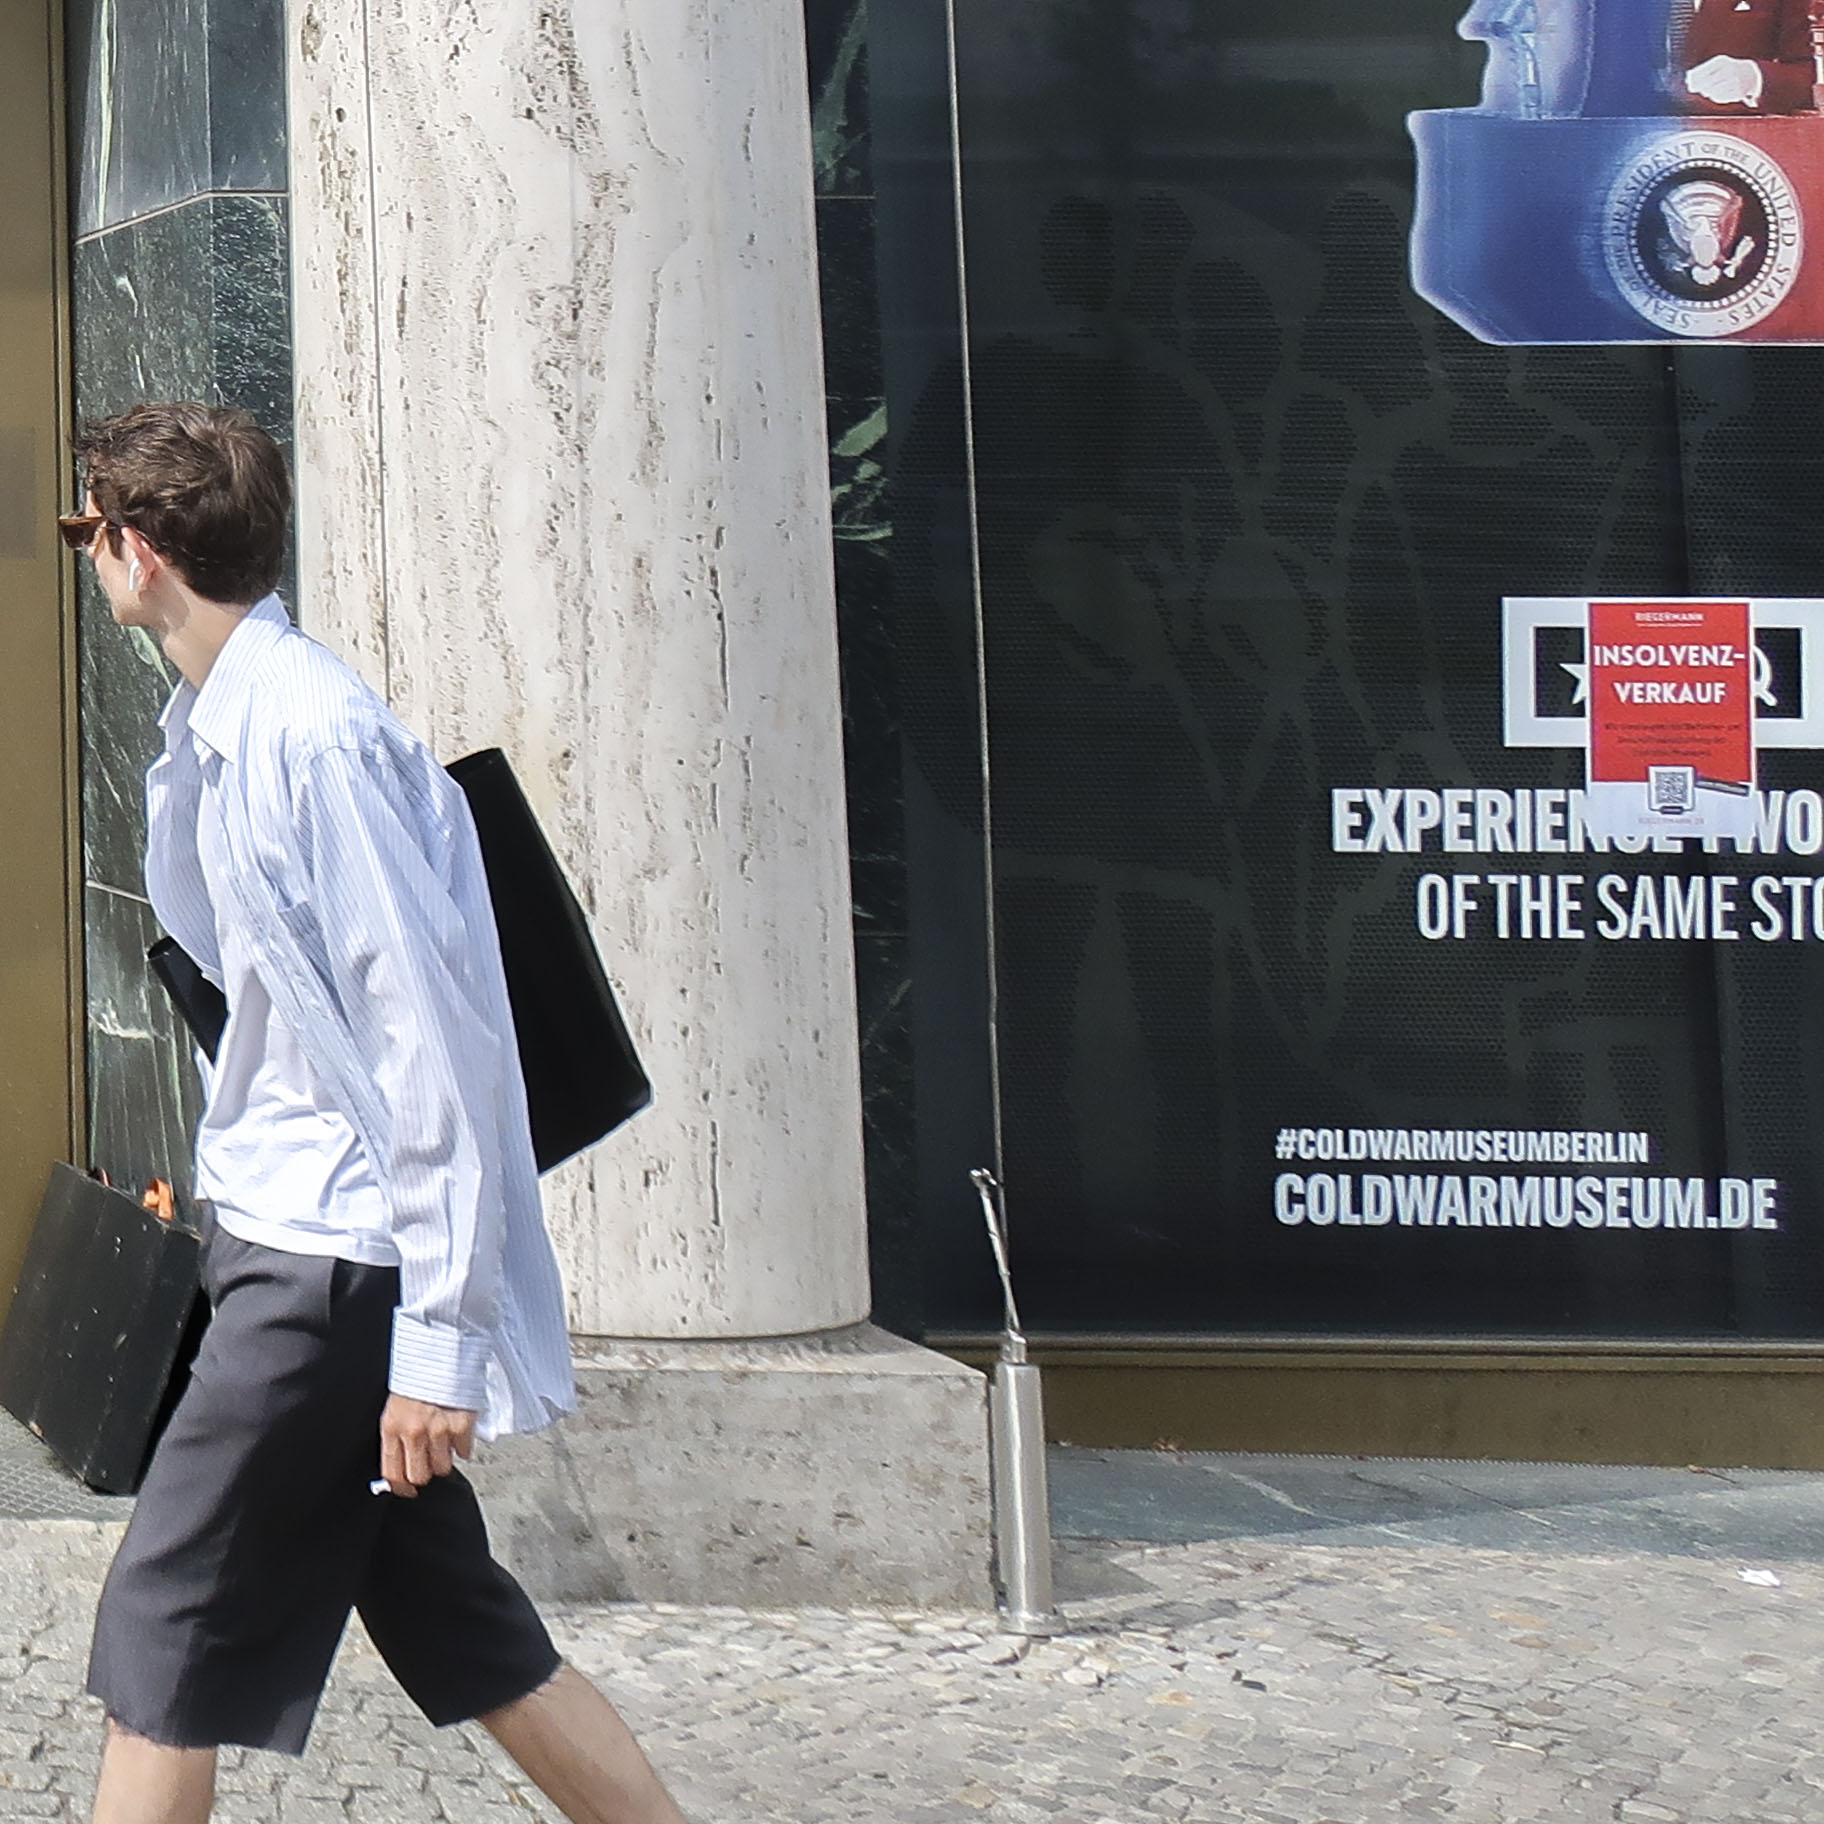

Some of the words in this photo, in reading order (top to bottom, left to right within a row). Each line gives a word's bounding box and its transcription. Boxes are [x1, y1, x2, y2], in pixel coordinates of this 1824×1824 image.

[1754, 163, 1798, 247] UNITED
[1727, 263, 1792, 327] STATES
[1593, 644, 1746, 667] INSOLVENZ-
[1613, 681, 1727, 704] VERKAUF
[1417, 873, 1480, 940] OF
[1486, 874, 1585, 940] THE
[1596, 874, 1740, 940] SAME
[1275, 1128, 1649, 1164] #COLDWARMUSEUMBERLIN
[1274, 1172, 1778, 1230] COLDWARMUSEUM.DE
